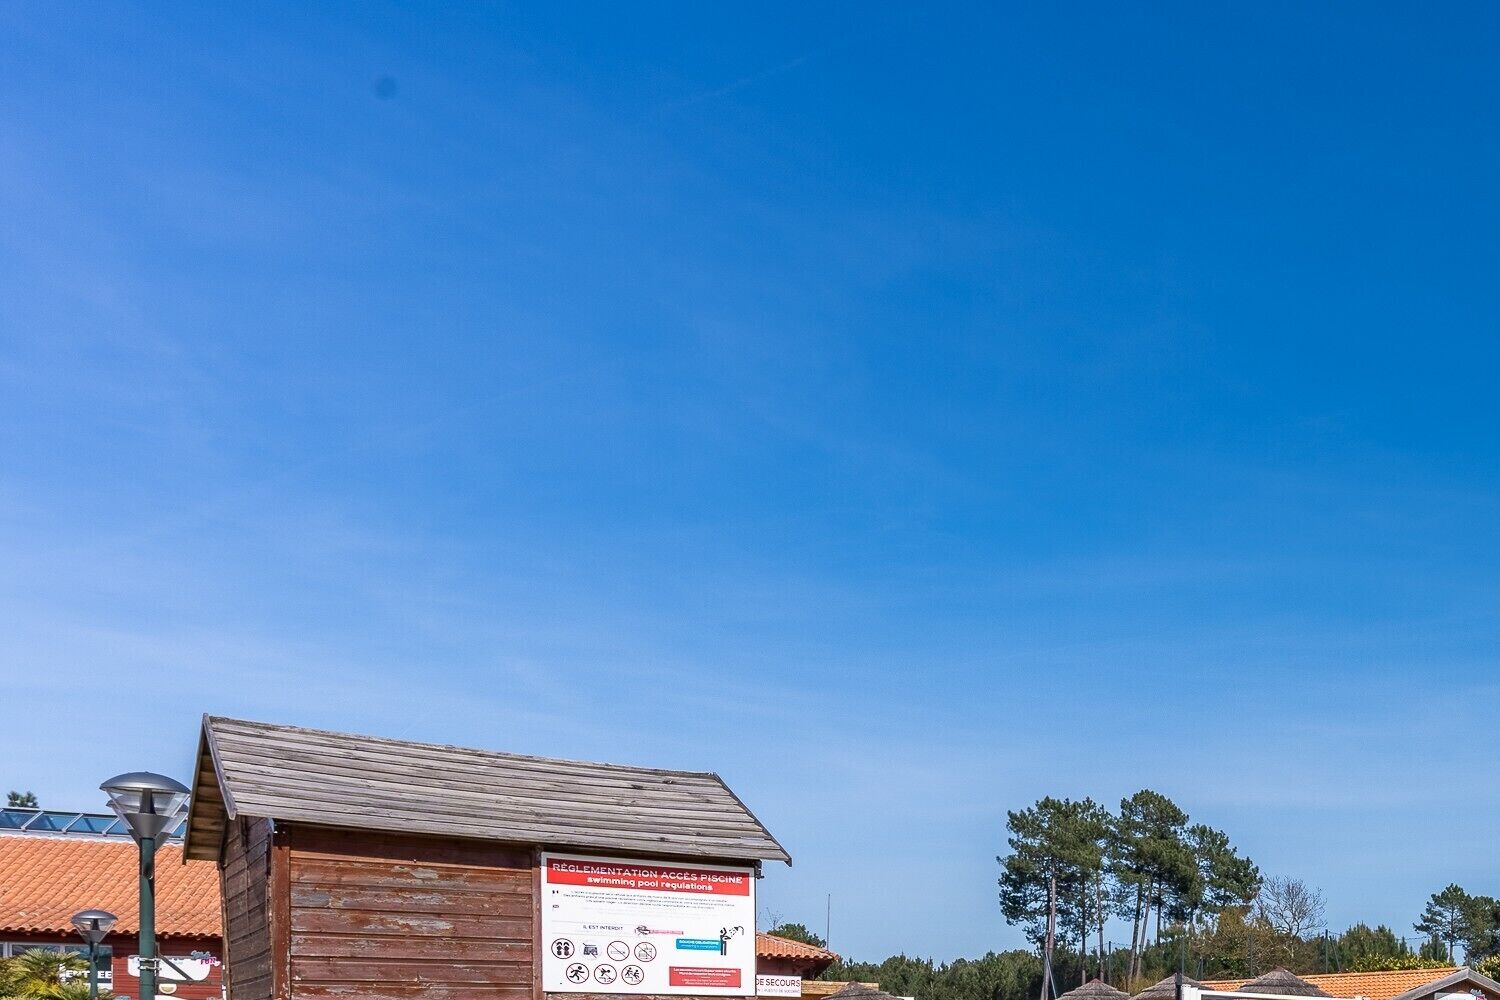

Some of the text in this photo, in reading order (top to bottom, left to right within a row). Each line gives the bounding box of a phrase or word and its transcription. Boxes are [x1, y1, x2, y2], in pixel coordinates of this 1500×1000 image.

[587, 876, 713, 891] swimming pool regulations
[700, 874, 743, 884] PISCINE
[765, 979, 800, 988] SECOURS
